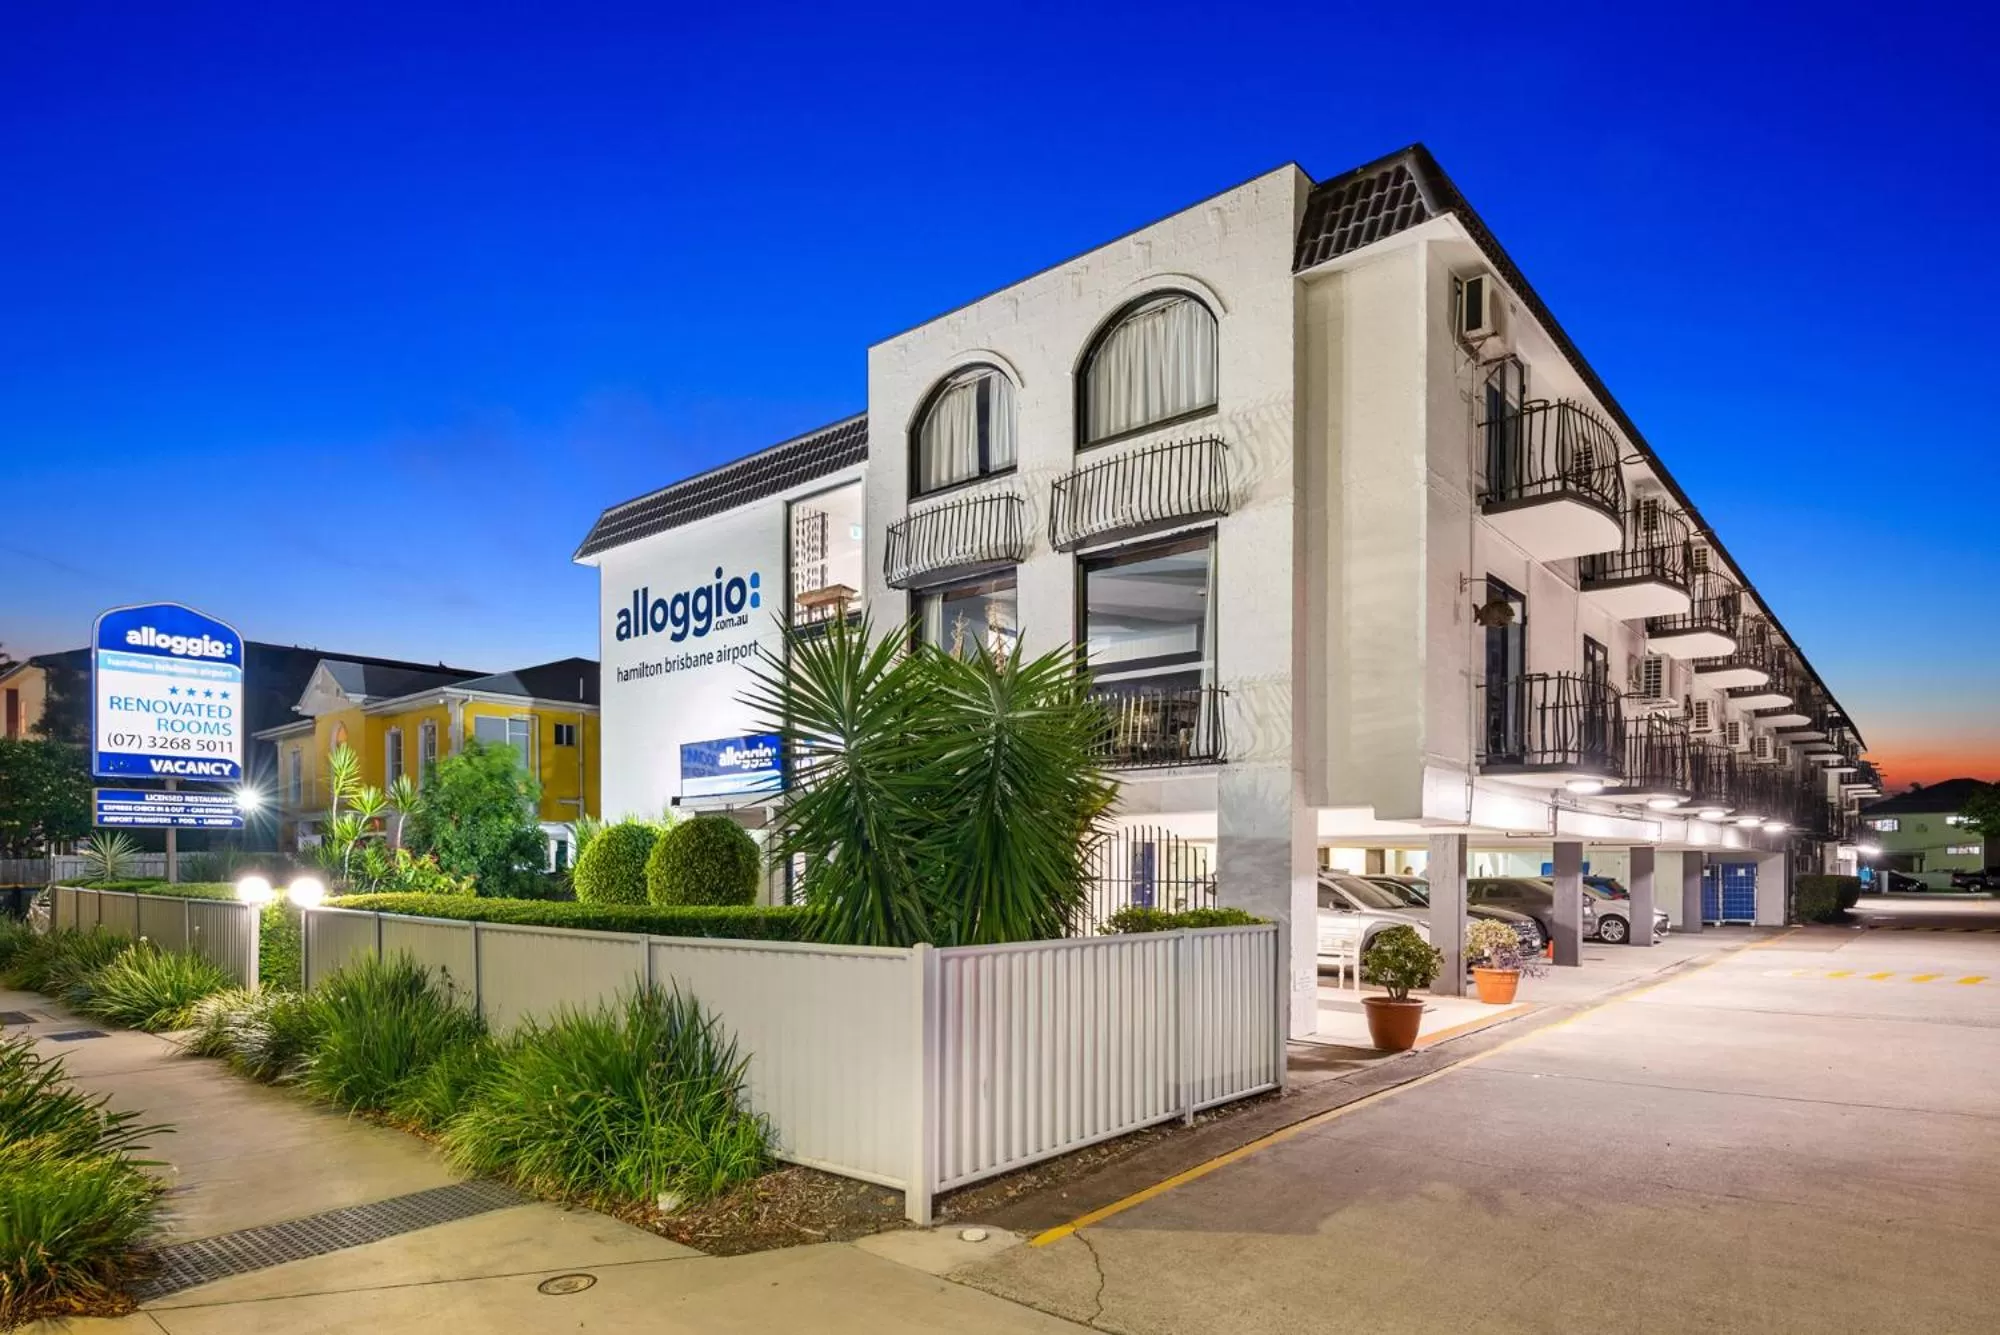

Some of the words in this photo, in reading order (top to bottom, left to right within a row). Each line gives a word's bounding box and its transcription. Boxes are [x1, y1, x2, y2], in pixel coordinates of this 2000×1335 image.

[713, 614, 748, 632] .com.au
[616, 660, 662, 683] hamilton
[665, 652, 714, 674] brisbane
[716, 640, 759, 665] airport
[109, 695, 232, 719] RENOVATED
[157, 718, 232, 737] ROOMS
[107, 732, 143, 749] (07)
[147, 735, 191, 751] 3268
[196, 739, 233, 753] 5011
[150, 758, 232, 776] VACANCY
[145, 793, 183, 802] LICENSED
[103, 815, 133, 823] AIRPORT
